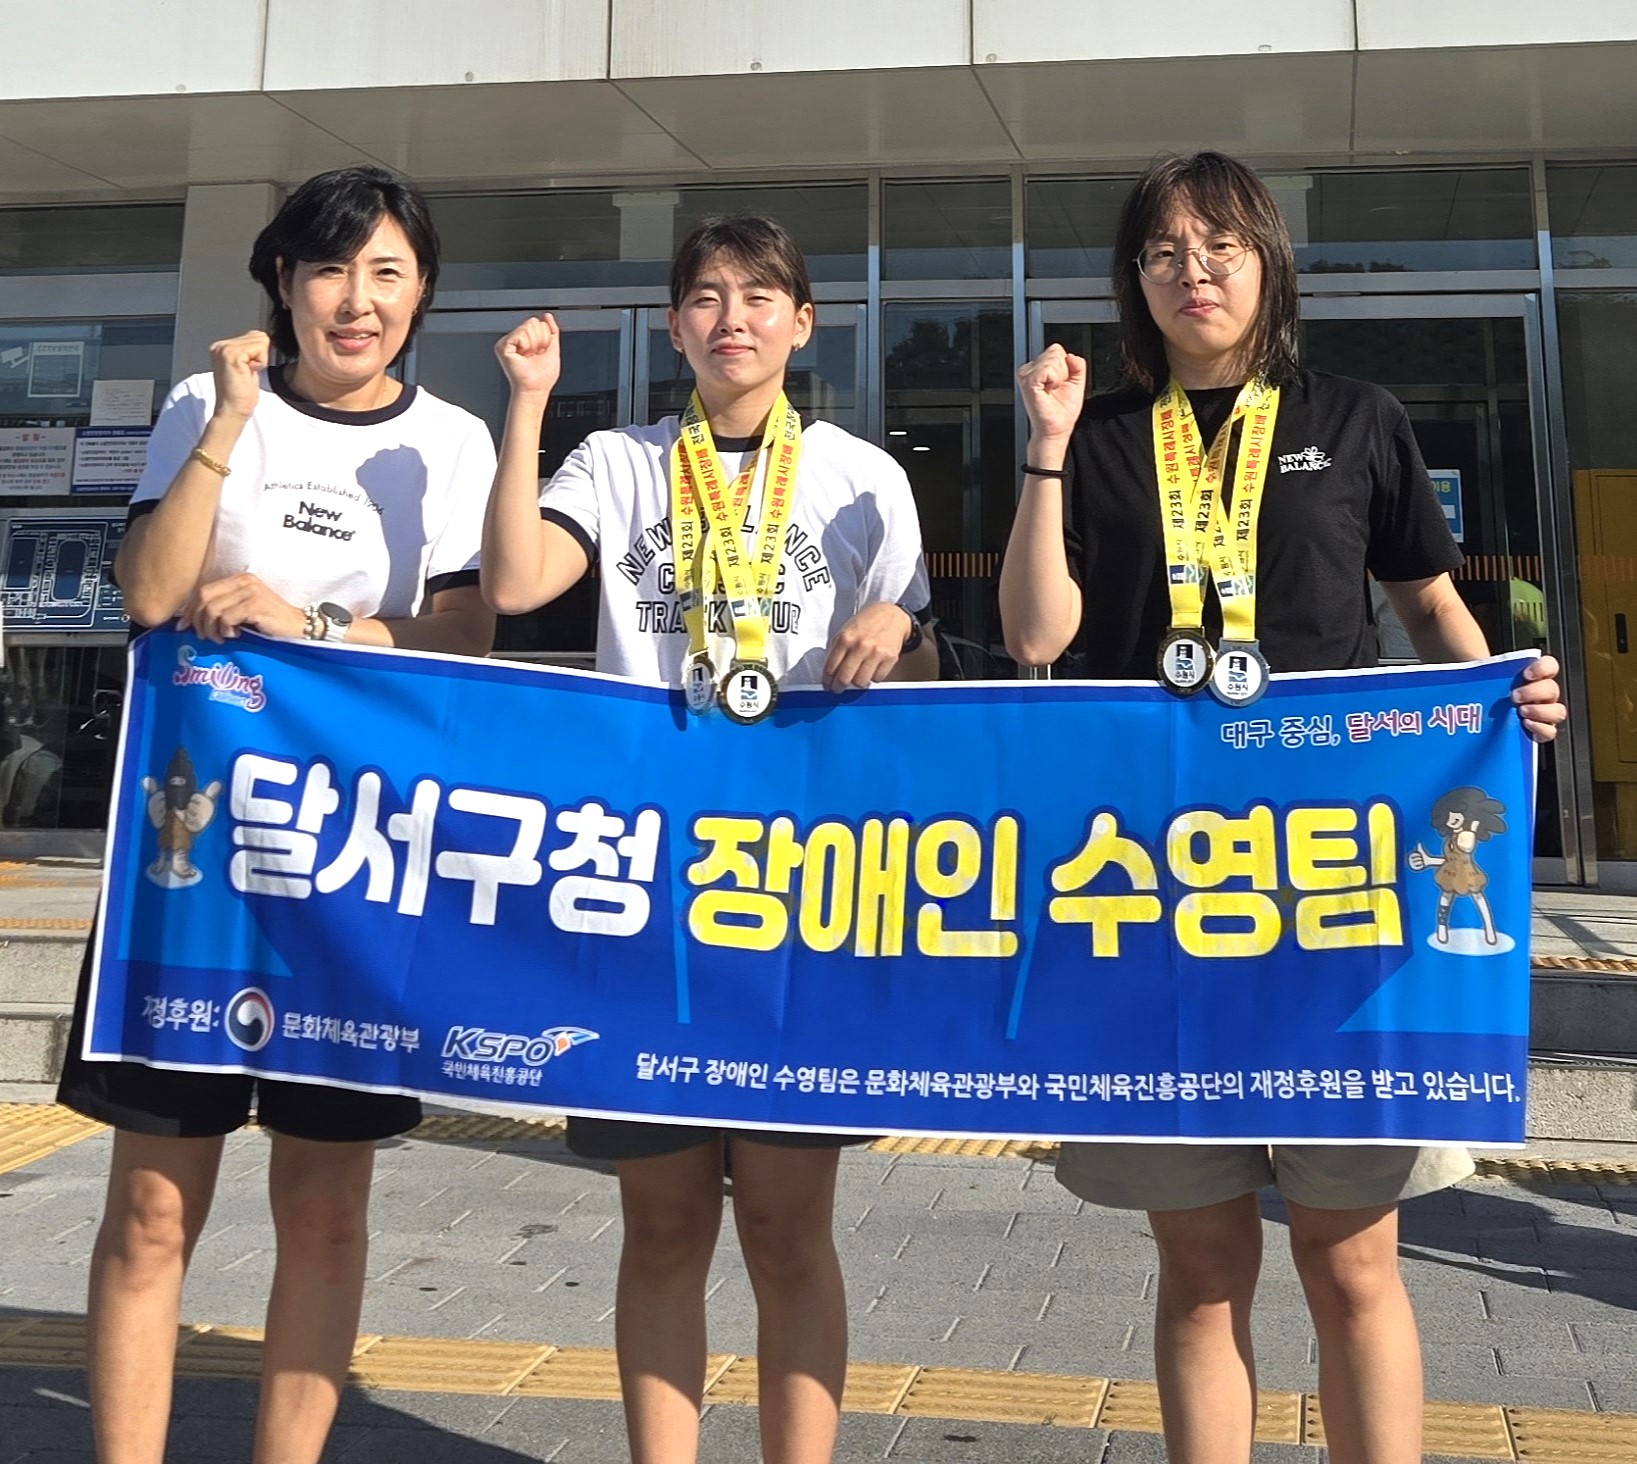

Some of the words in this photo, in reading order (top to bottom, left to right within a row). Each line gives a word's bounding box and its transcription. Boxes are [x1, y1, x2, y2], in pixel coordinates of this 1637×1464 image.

[1160, 409, 1180, 484] 수원특례시장배
[1242, 415, 1267, 492] 수원특례시장배
[1278, 453, 1303, 465] NEW
[696, 448, 728, 521] 수원특례시장배
[761, 523, 779, 564] 제23회
[771, 444, 793, 519] 수원특례시장배
[282, 514, 353, 541] Balance
[298, 501, 343, 521] New
[1169, 490, 1184, 529] 제23회
[1195, 489, 1214, 533] 제23회
[1237, 499, 1253, 541] 제23회
[616, 516, 674, 586] NEW
[681, 521, 694, 561] 제23회
[718, 527, 739, 567] 제23회
[636, 601, 728, 634] TRAK
[1221, 720, 1275, 749] 대구
[1278, 715, 1341, 748] 중심,
[1346, 710, 1422, 744] 달서의
[1428, 702, 1482, 736] 시대
[230, 754, 661, 937] 달서구청
[687, 816, 1018, 957] 장애인
[1049, 802, 1403, 957] 수영팀
[282, 1011, 421, 1053] 문화체육관광부
[441, 1026, 554, 1066] KSPO
[442, 1061, 543, 1087] 국민체육진흥공단
[636, 1052, 700, 1083] 달서구
[704, 1059, 769, 1089] 장애인
[773, 1064, 861, 1095] 수영팀은
[864, 1069, 1040, 1101] 문화체육관광부와
[1044, 1070, 1244, 1102] 국민체육진흥공단의
[1250, 1069, 1366, 1099] 재정후원을
[1371, 1069, 1419, 1099] 받고
[1422, 1071, 1521, 1103] 있습니다.
